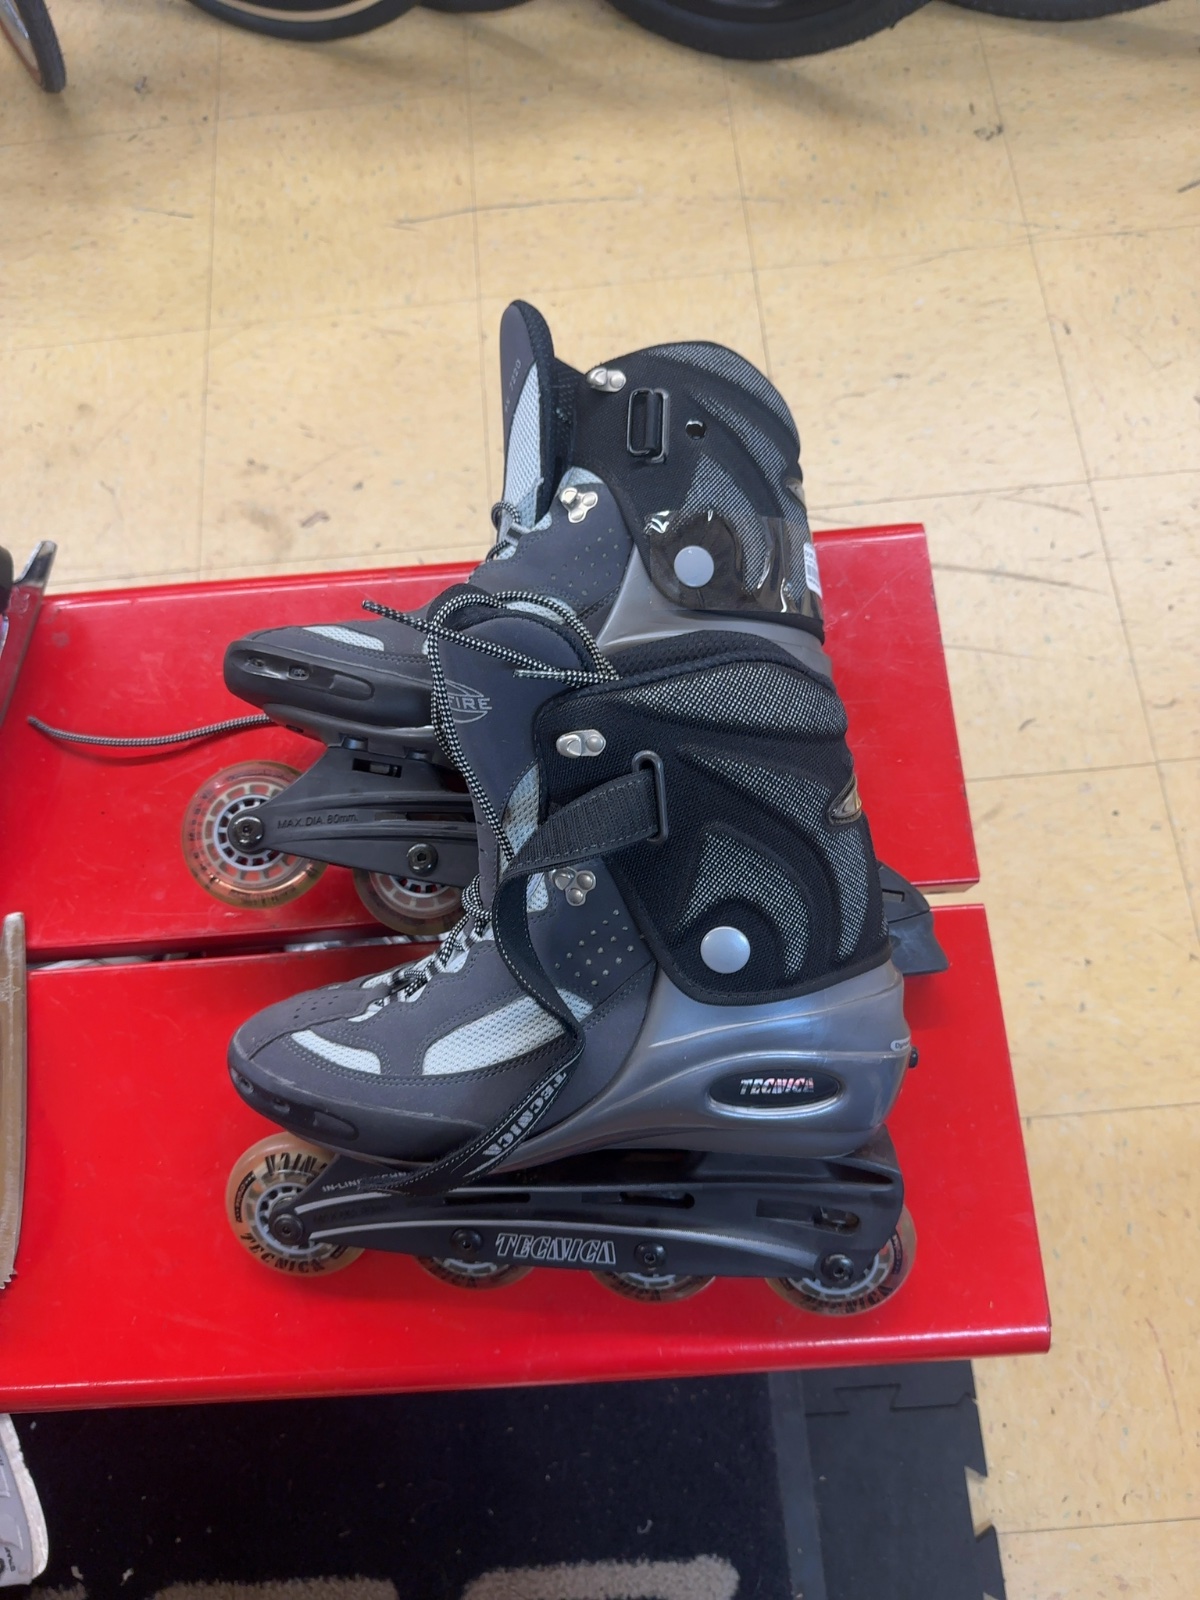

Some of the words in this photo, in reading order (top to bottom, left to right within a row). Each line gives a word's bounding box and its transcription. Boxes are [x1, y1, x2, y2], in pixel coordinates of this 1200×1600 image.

[740, 1077, 815, 1095] TECNICA
[482, 1071, 567, 1156] TECNICA
[495, 1232, 616, 1265] TECNICA
